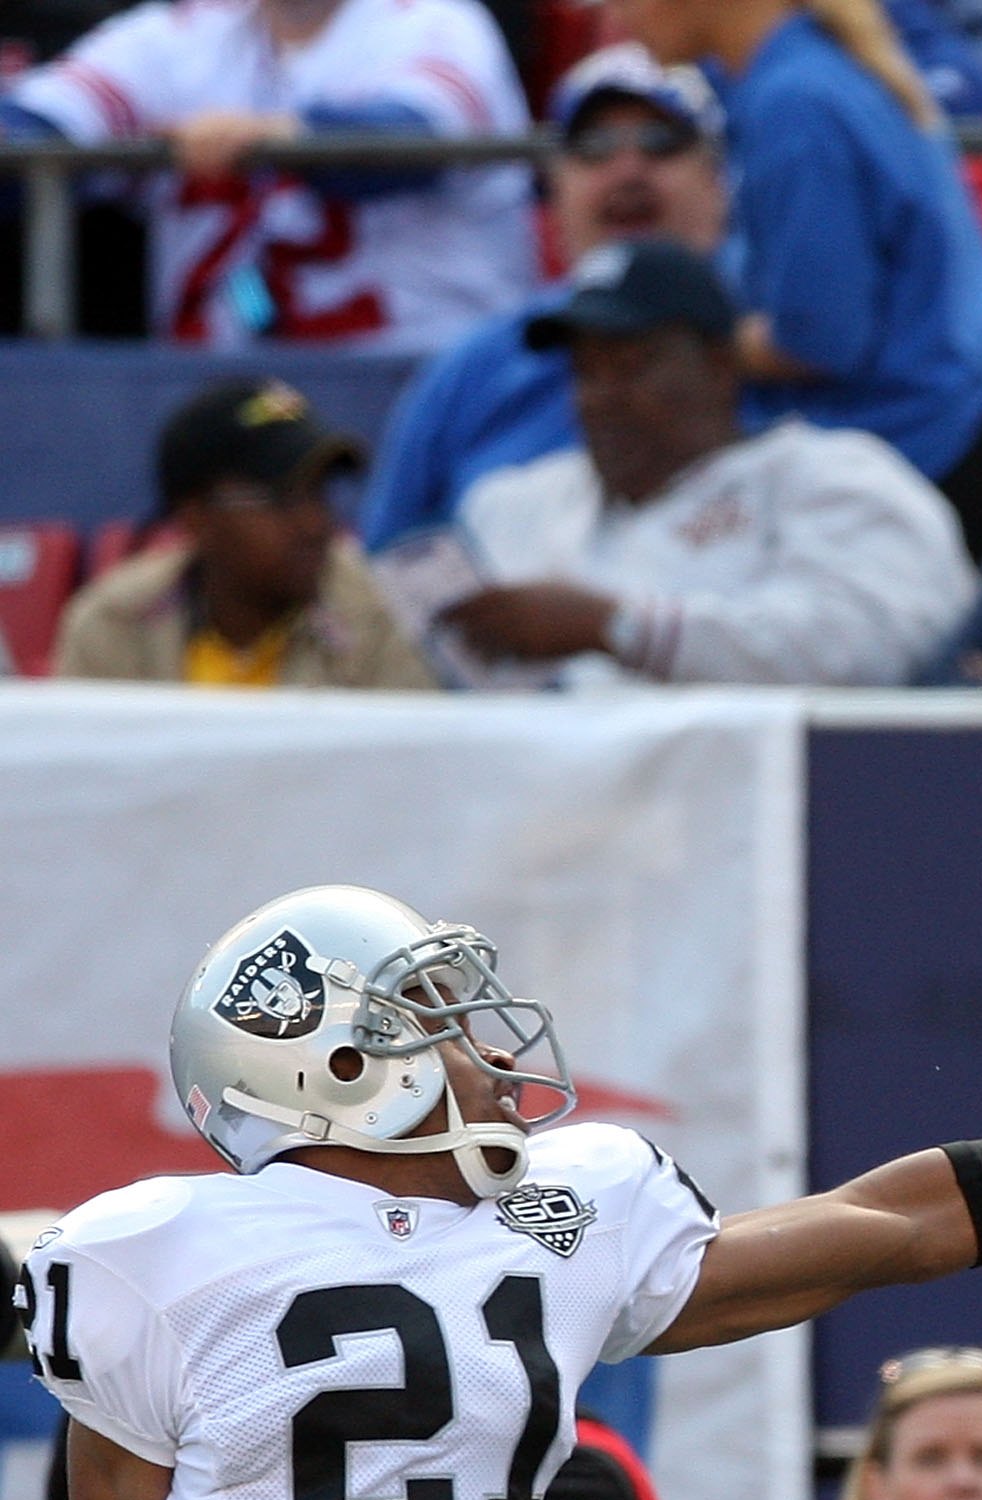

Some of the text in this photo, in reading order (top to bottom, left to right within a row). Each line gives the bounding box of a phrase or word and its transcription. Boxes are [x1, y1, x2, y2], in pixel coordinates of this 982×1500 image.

[173, 170, 391, 342] 72
[221, 938, 287, 1007] RAIDERS
[507, 1194, 578, 1223] 50
